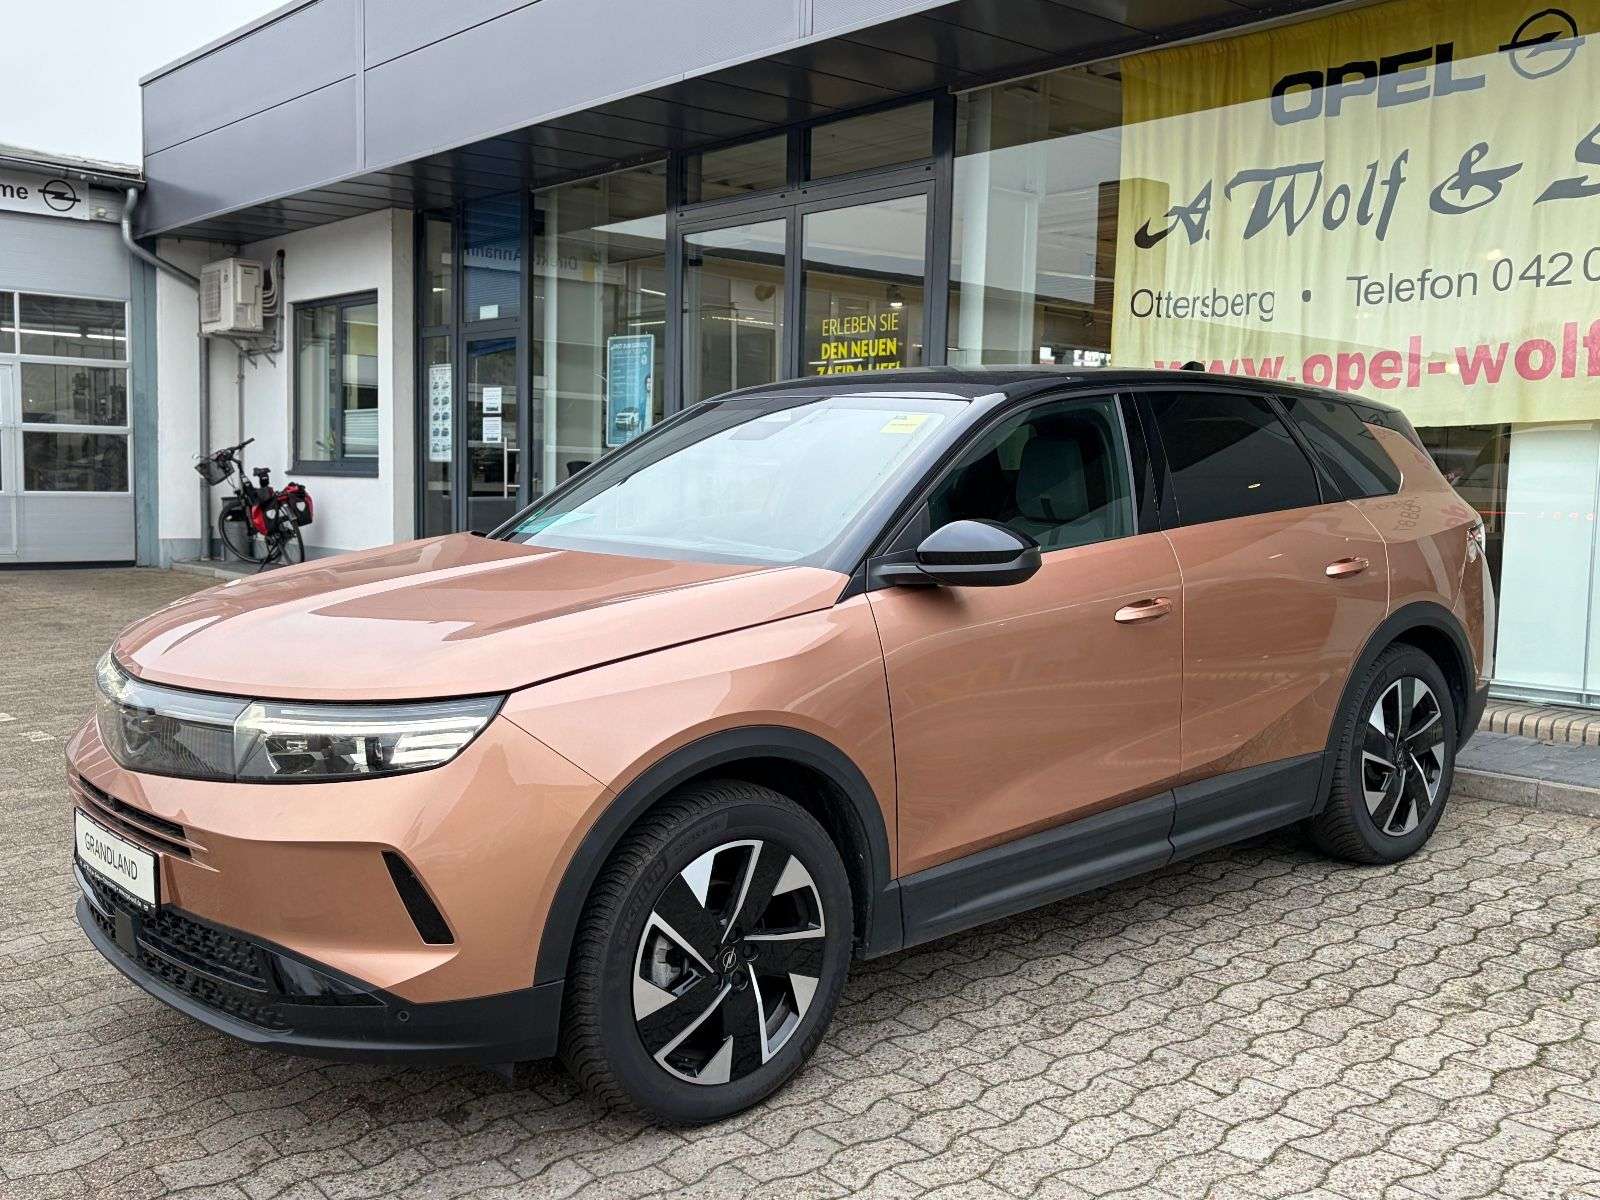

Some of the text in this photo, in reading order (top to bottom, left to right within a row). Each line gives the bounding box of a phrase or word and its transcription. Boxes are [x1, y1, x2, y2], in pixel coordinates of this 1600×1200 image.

[1271, 42, 1485, 126] OPEL
[1224, 149, 1409, 241] Wolf
[1430, 142, 1523, 214] &
[1130, 287, 1276, 322] Ottersberg
[1347, 268, 1478, 307] Telefon
[821, 337, 897, 360] DEN NEUEN
[822, 312, 899, 336] ERLEBEN SIE
[84, 832, 138, 880] GRANDLAND
